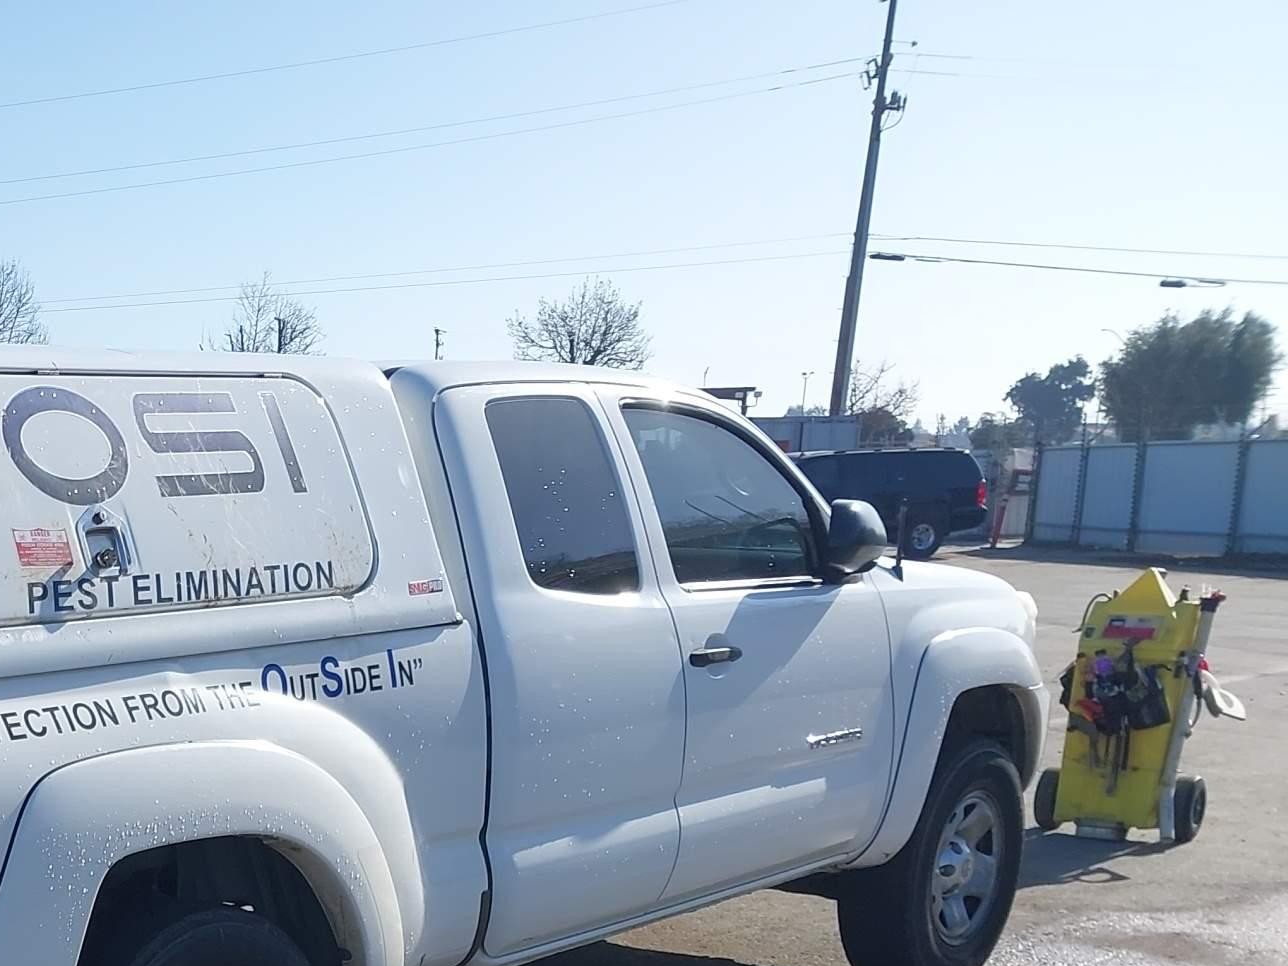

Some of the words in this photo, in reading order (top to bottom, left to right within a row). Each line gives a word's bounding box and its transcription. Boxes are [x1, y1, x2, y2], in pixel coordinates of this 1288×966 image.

[2, 386, 308, 506] OSI
[27, 575, 120, 614] PEST
[132, 560, 334, 605] ELIMINATION
[122, 687, 207, 724] FROM
[206, 681, 262, 711] THE
